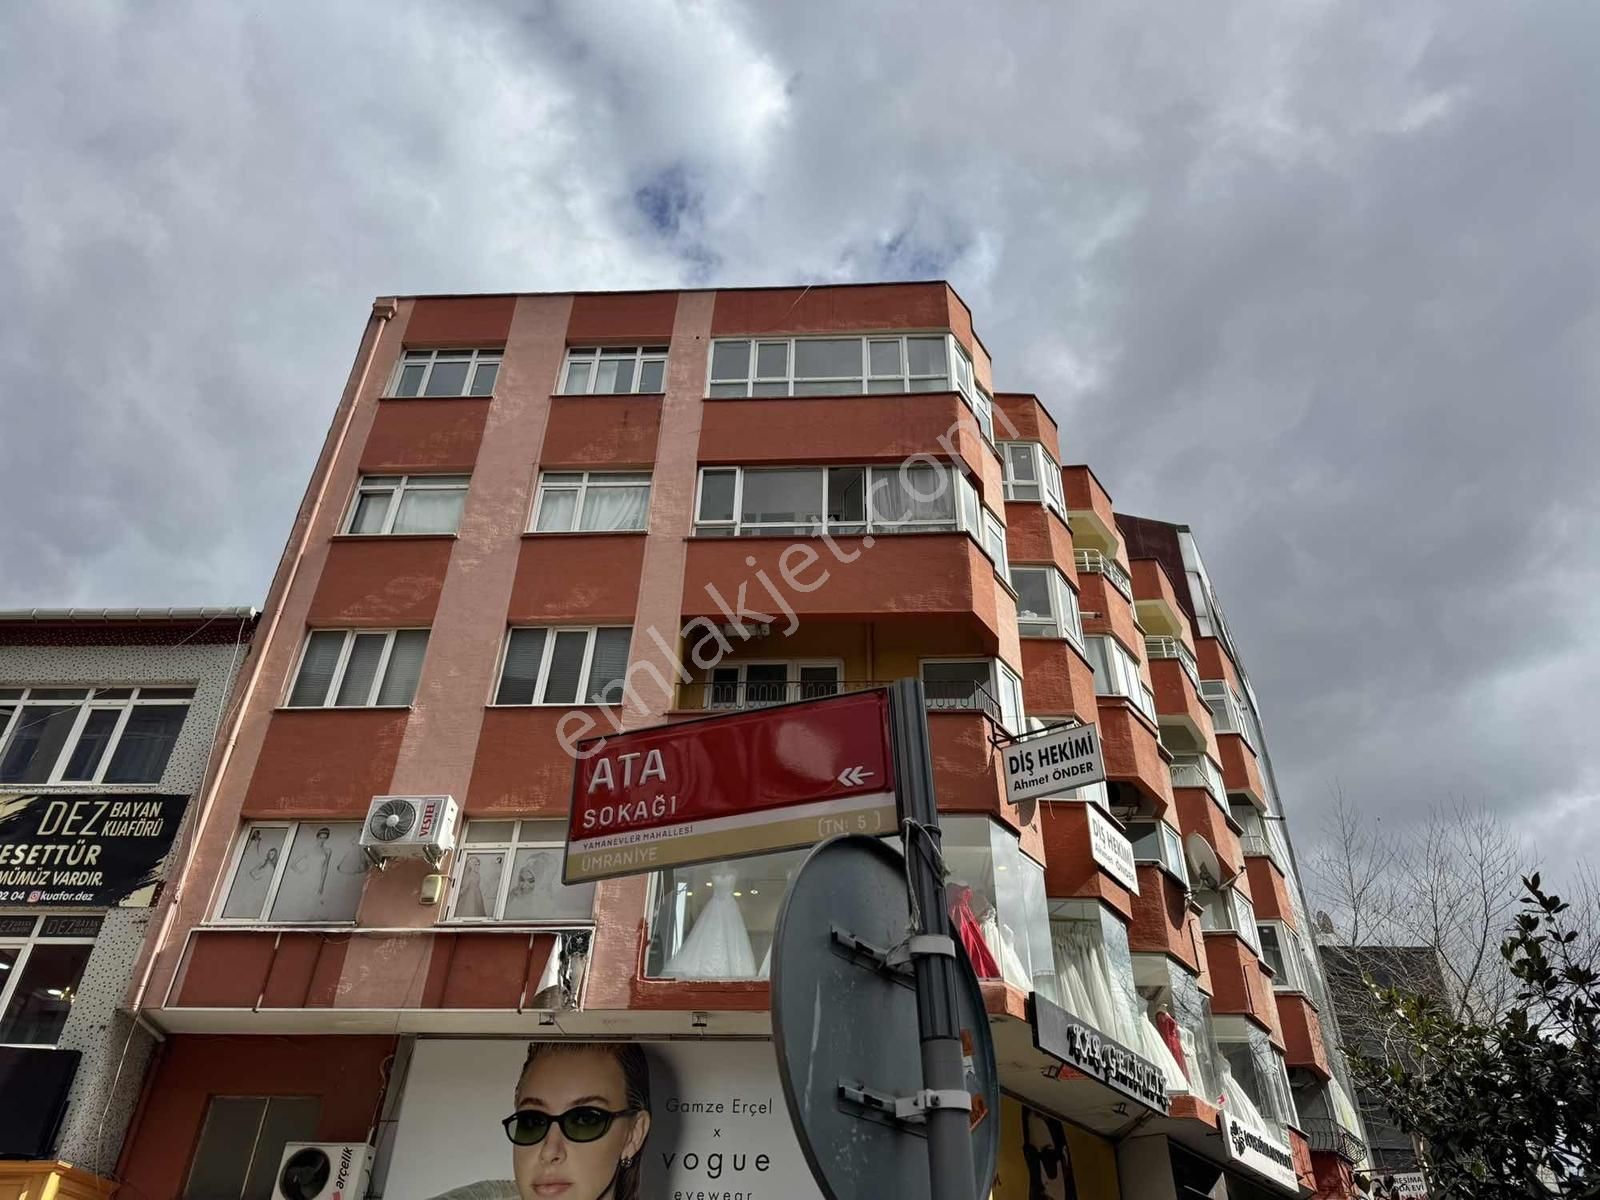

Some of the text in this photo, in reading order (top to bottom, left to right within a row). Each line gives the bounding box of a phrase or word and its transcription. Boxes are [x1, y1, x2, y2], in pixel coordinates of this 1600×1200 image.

[1009, 731, 1094, 776] DİŞ HEKİMİ
[587, 749, 666, 794] ATA
[1014, 761, 1094, 791] Ahmet ÖNDER
[36, 801, 110, 835] DEZ
[109, 801, 163, 818] BAYAN
[419, 802, 436, 837] VESTEL
[582, 795, 677, 828] SOKAĞI
[100, 818, 164, 837] KUAFÖRÜ
[583, 825, 693, 850] YAMANEVLER MAHALLESİ
[0, 838, 102, 866] ESETTÜR
[582, 847, 657, 872] ÜMRANİYE
[52, 871, 103, 886] VARDIR.
[10, 890, 26, 901] 04
[41, 890, 94, 901] kuafor.dez
[666, 1098, 772, 1117] Gamze Erçel
[335, 1146, 353, 1190] arçelik
[662, 1152, 771, 1179] vogue
